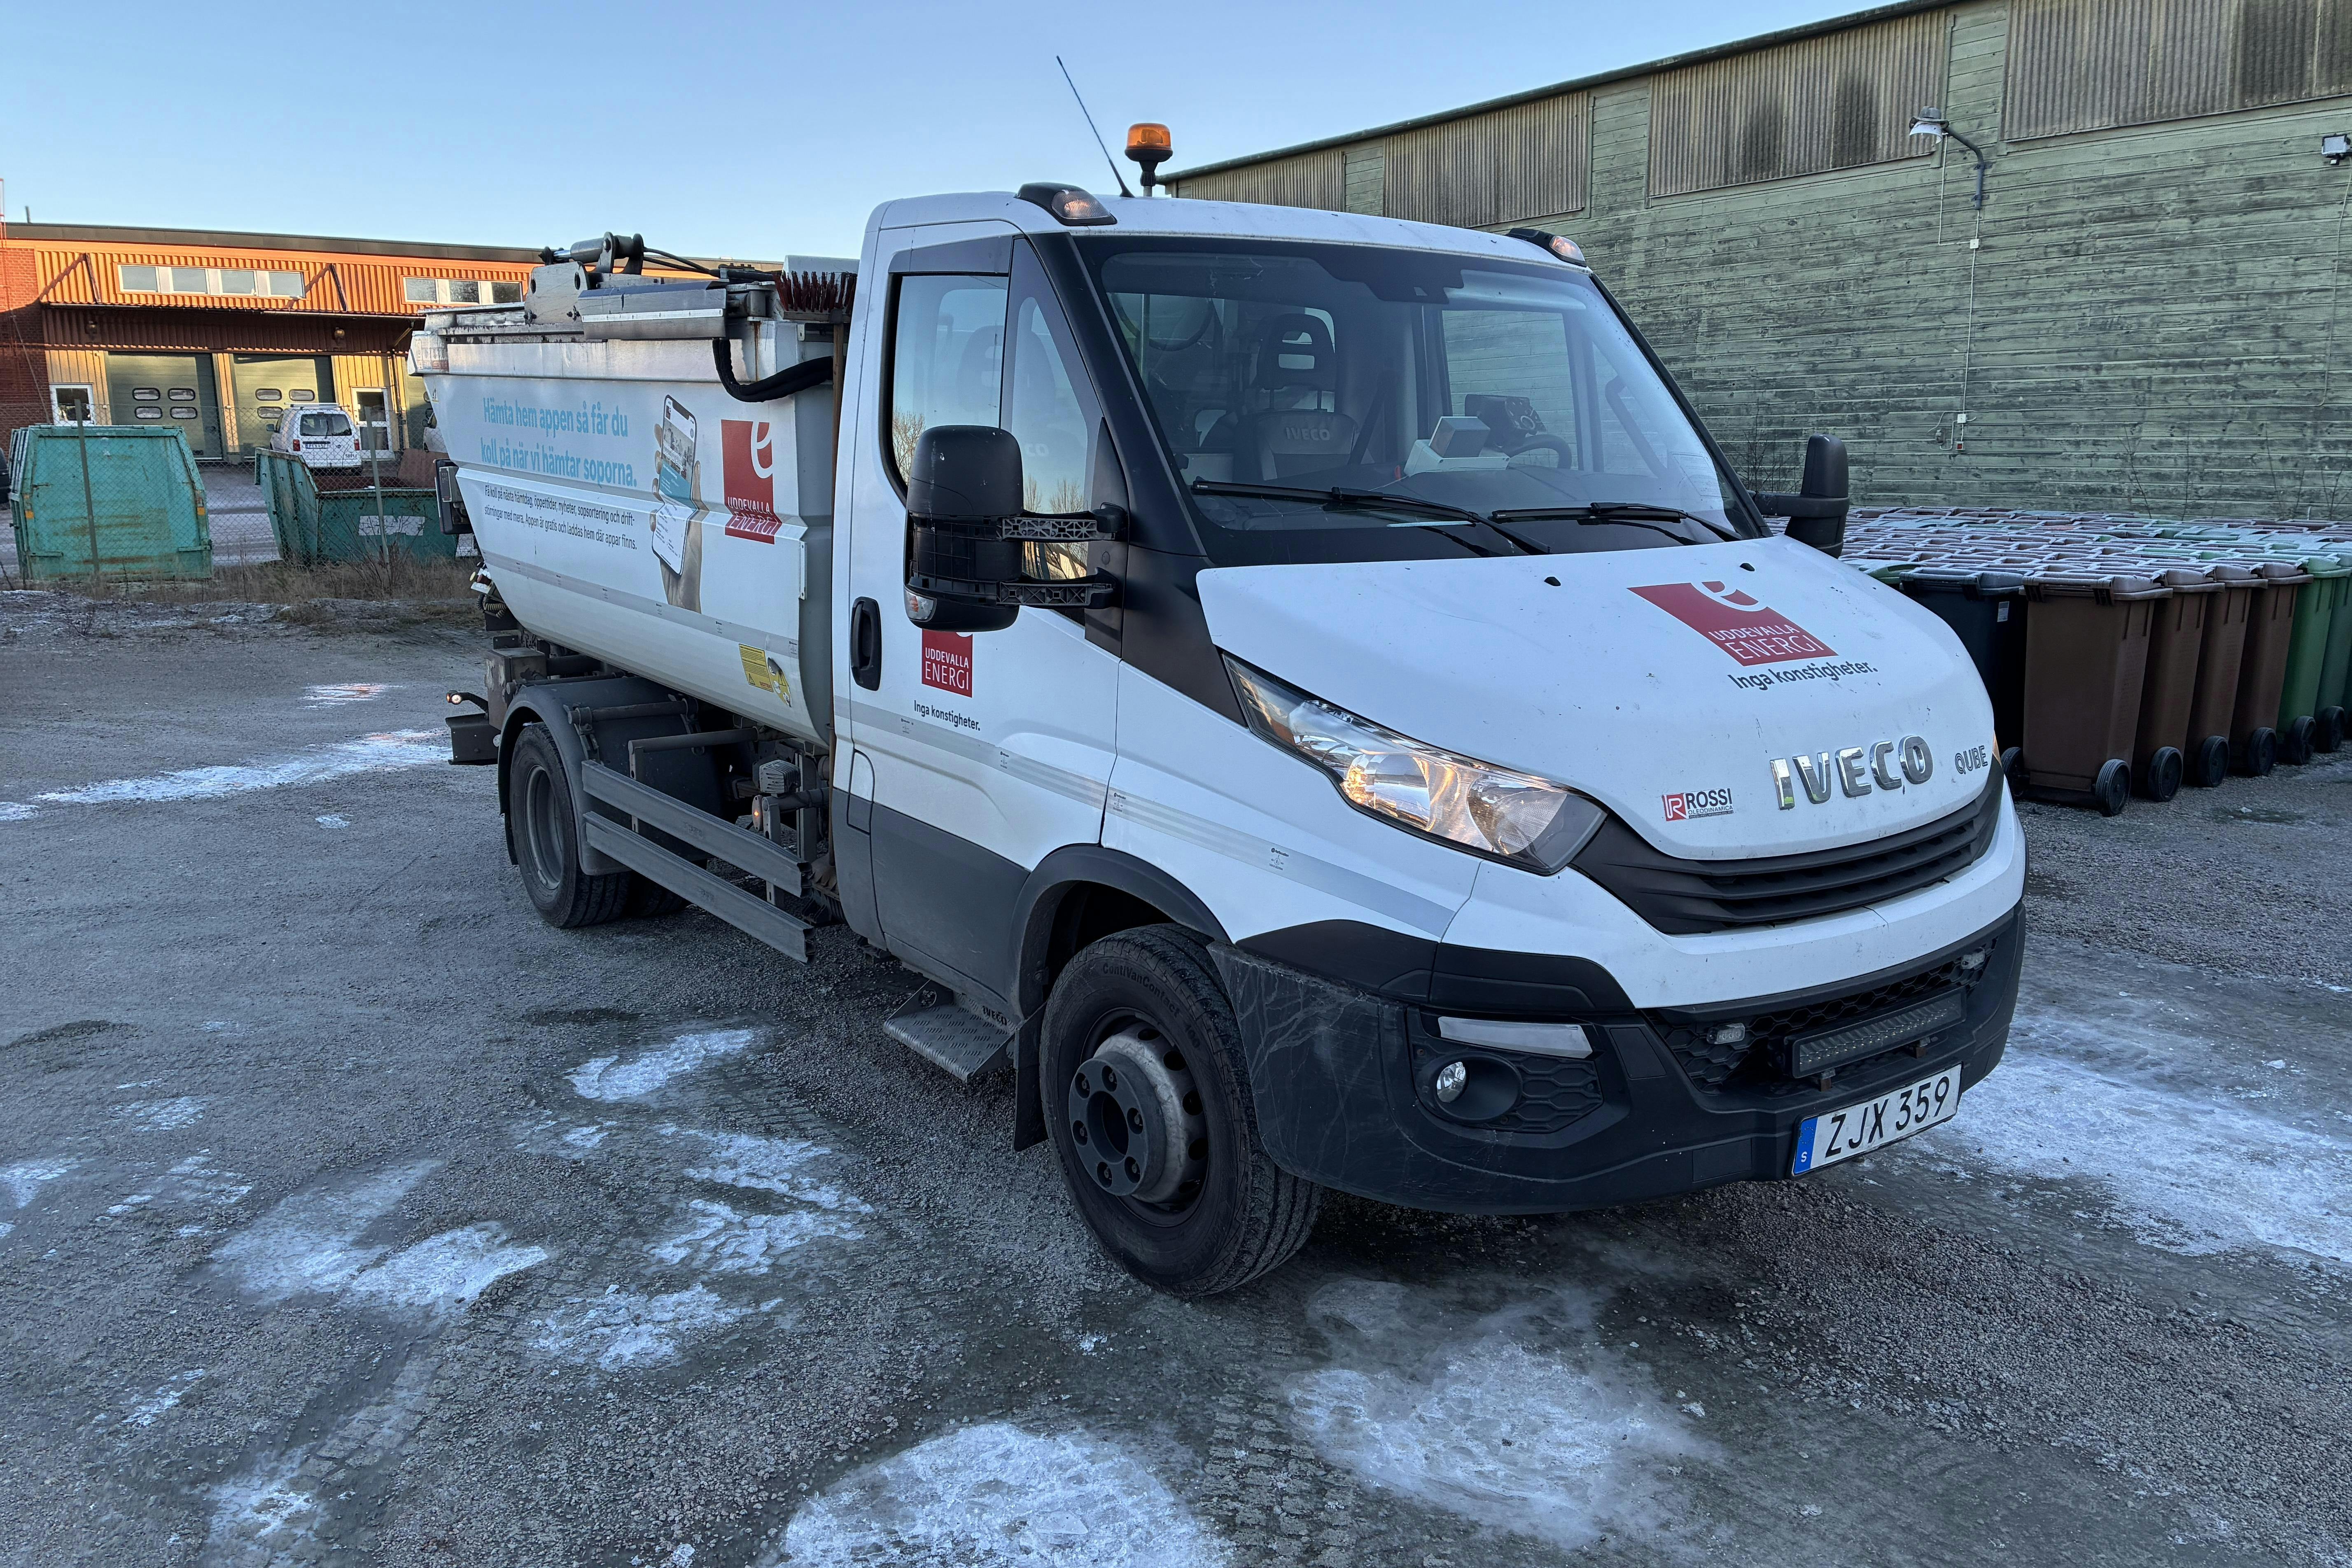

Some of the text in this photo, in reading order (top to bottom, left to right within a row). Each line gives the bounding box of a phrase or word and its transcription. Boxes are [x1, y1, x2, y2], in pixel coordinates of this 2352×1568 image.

[483, 397, 628, 438] Hämta hem appen så får du
[1285, 427, 1330, 441] IVECO
[481, 436, 498, 464] koll
[499, 437, 511, 471] på
[513, 441, 529, 469] när
[530, 442, 540, 472] vi
[542, 444, 581, 478] hämtar
[583, 458, 637, 488] soporna.
[485, 484, 490, 497] Få
[498, 487, 503, 501] på
[503, 489, 514, 502] nästa
[514, 490, 534, 508] hämtdag,
[534, 495, 558, 512] öppettider,
[558, 500, 576, 516] nyheter,
[578, 506, 609, 524] sopsortering
[610, 510, 620, 524] och
[621, 511, 635, 526] drift-
[727, 496, 773, 516] UDDEVALLA
[484, 504, 637, 550] störningar med mera. Appen är gratis och laddas hem där appar finns.
[728, 511, 779, 535] ENERGI
[1708, 624, 1801, 641] UDDEVALLA
[1724, 635, 1825, 660] ENERGI
[925, 646, 969, 669] UDDEVALLA
[925, 660, 969, 691] ENERGI
[1727, 660, 1878, 691] Inga konstigheter.
[914, 700, 930, 717] Inga
[931, 704, 981, 731] konstigheter.
[1769, 735, 1934, 811] IVECO
[1954, 745, 1988, 775] QUBE
[1685, 788, 1733, 810] ROSSI
[1688, 805, 1734, 815] OLEODINAMICA
[982, 1005, 1008, 1026] IVECO
[1102, 962, 1201, 1049] ContiVanContact 100
[1825, 1076, 1950, 1158] ZJX 359
[1800, 1151, 1808, 1163] S
